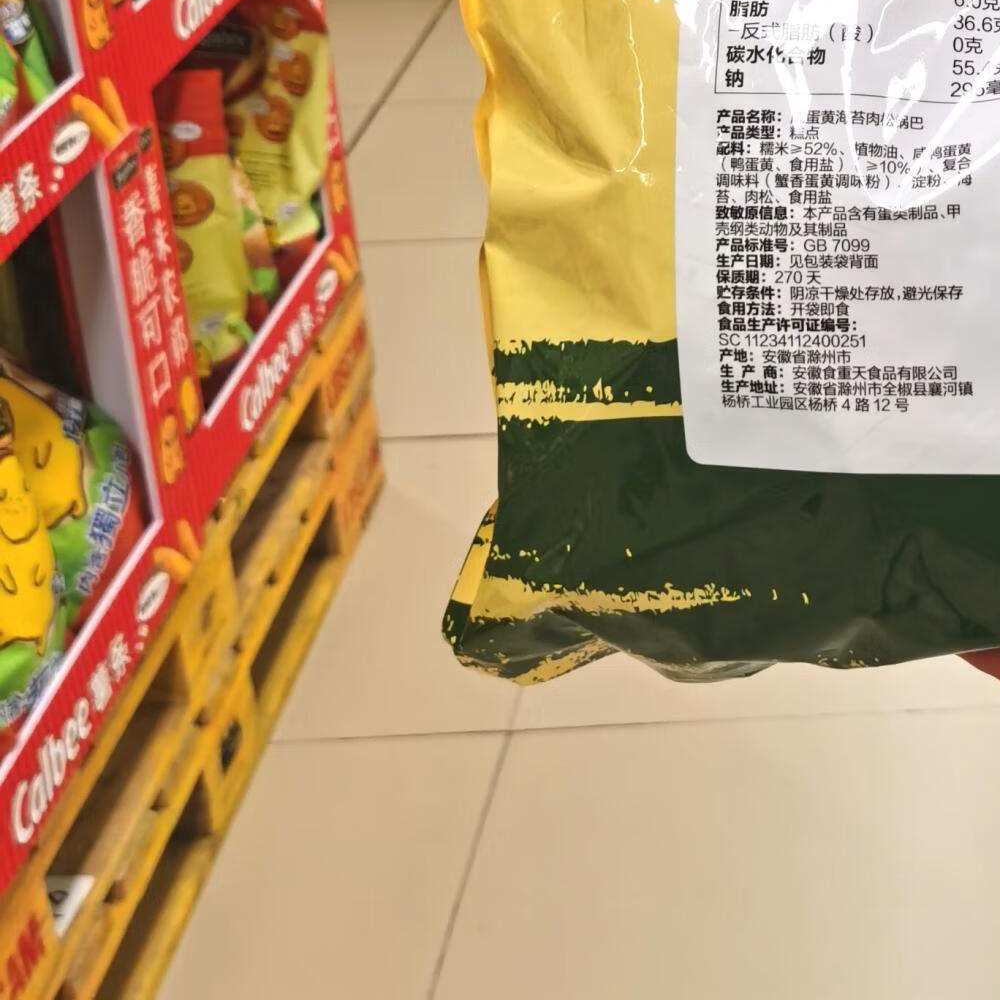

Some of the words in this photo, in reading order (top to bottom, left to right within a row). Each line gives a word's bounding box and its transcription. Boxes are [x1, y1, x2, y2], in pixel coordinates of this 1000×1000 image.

[729, 0, 770, 18] 脂肪
[726, 45, 826, 65] 碳水化合物
[953, 37, 983, 54] 0克
[725, 68, 744, 88] 钠
[715, 222, 848, 237] 壳纲类动物及其制品
[239, 341, 290, 432] Calbee
[11, 697, 93, 844] Calbee
